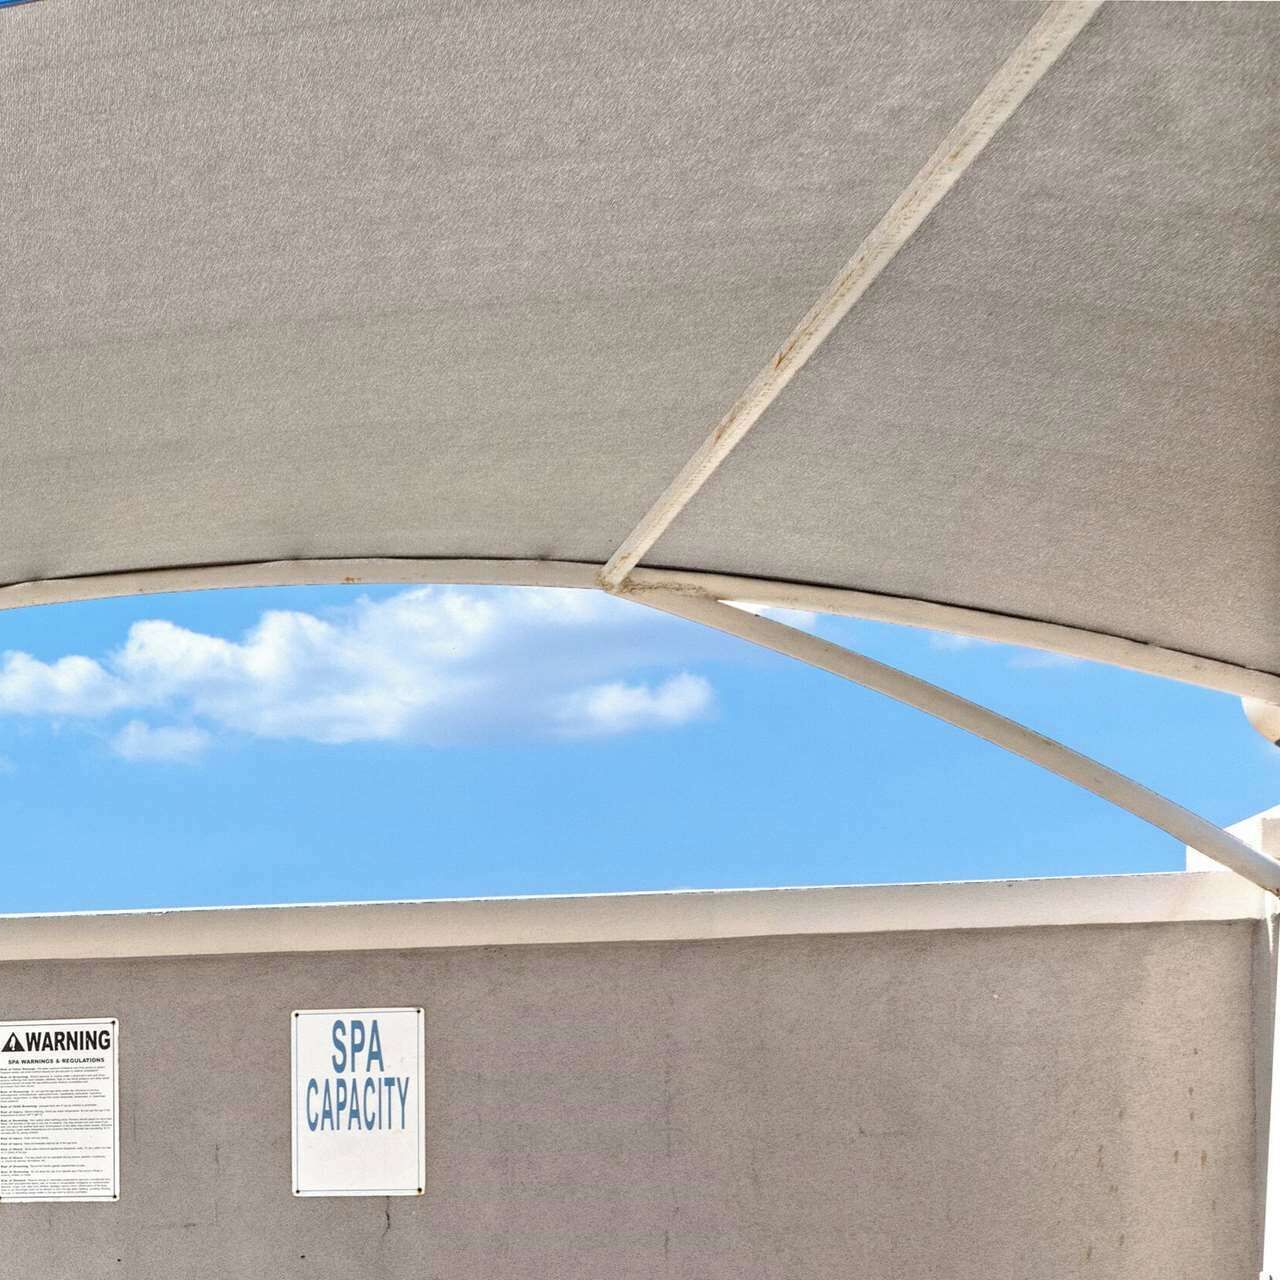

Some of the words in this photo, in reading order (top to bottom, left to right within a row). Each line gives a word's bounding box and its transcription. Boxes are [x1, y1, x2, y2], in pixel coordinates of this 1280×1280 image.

[25, 1030, 111, 1052] WARNING
[332, 1019, 384, 1073] SPA
[306, 1077, 409, 1131] CAPACITY
